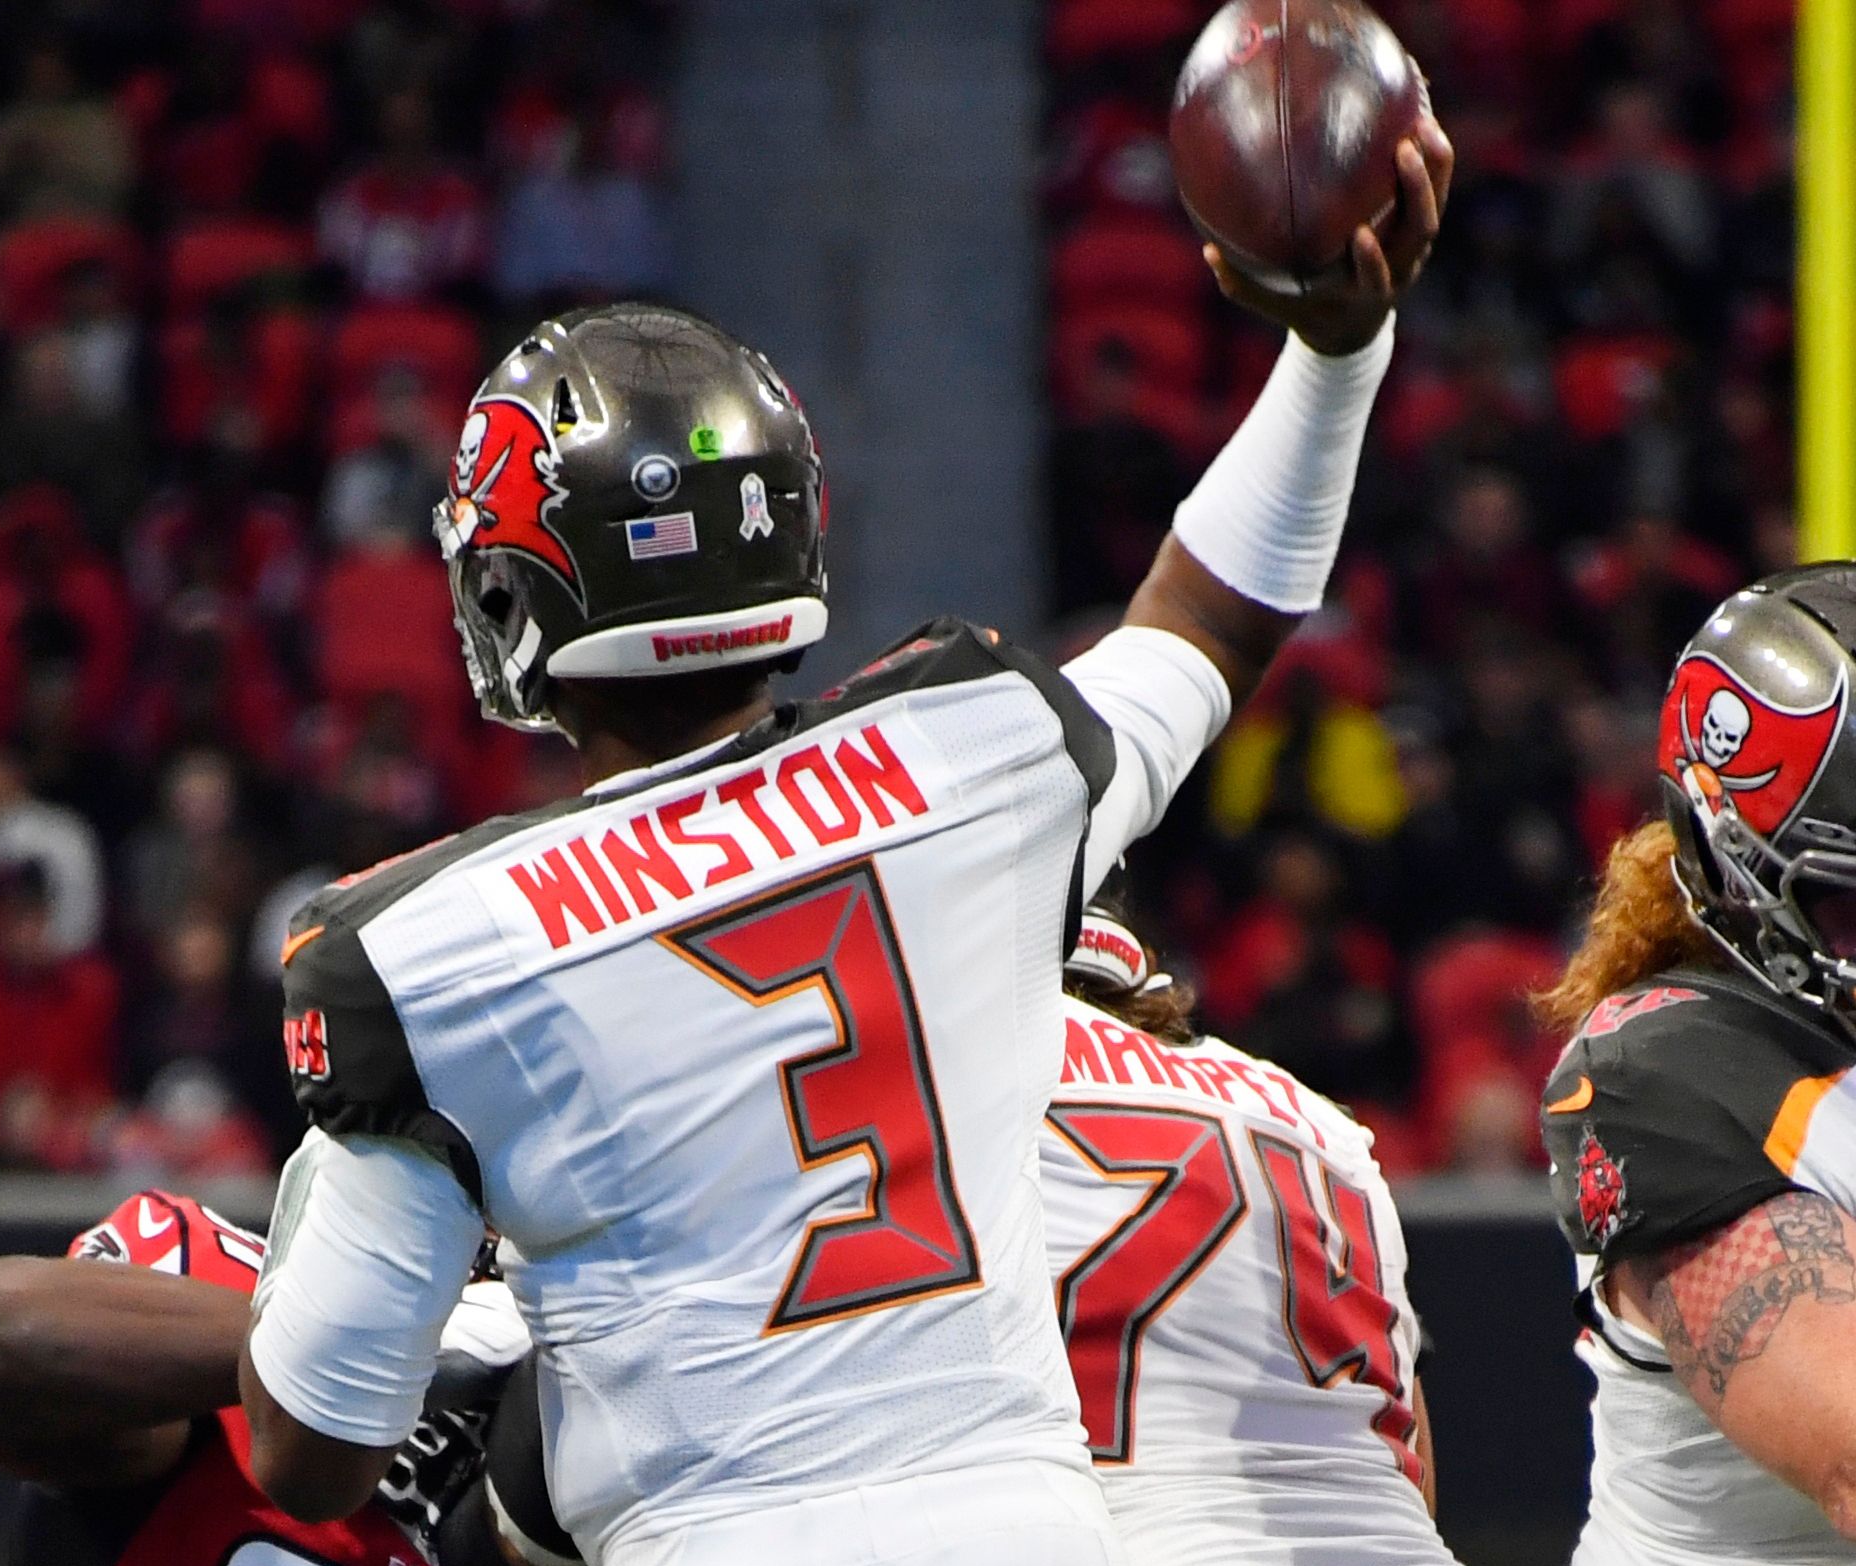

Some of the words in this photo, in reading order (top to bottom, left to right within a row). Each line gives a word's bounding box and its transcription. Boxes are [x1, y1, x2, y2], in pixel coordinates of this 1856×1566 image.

[652, 614, 793, 663] BUCCANEERS
[505, 724, 930, 950] WINSTON
[652, 853, 986, 1338] 3
[1037, 1098, 1428, 1498] 74
